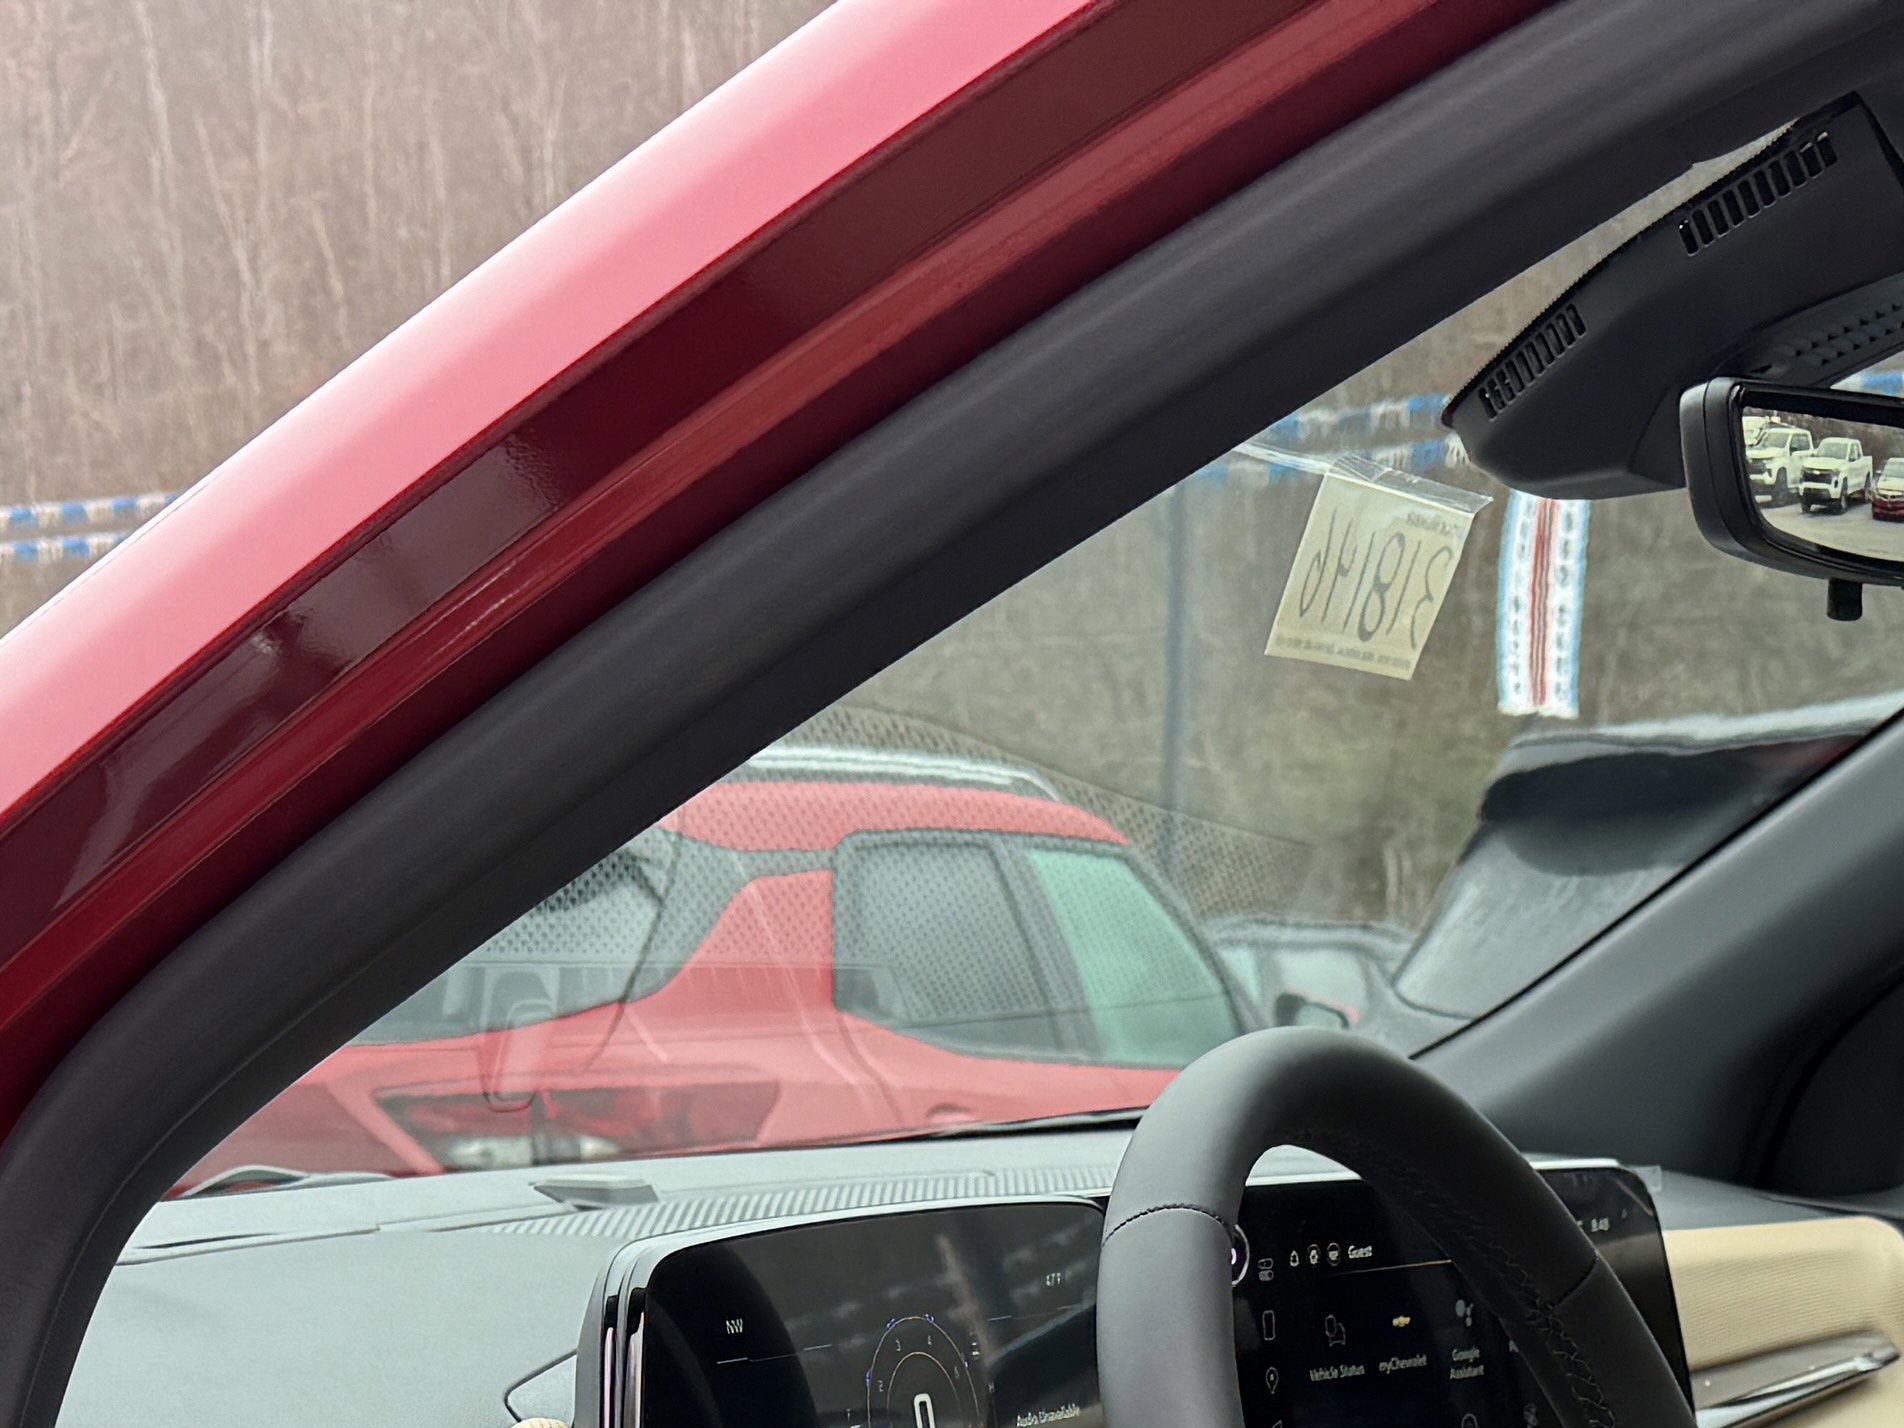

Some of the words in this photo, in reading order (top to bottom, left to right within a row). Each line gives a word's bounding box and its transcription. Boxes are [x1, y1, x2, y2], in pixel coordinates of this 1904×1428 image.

[1348, 1245, 1372, 1259] Guest
[1452, 1347, 1480, 1363] Google
[1309, 1366, 1339, 1382] Vehicle
[1339, 1362, 1365, 1378] Status
